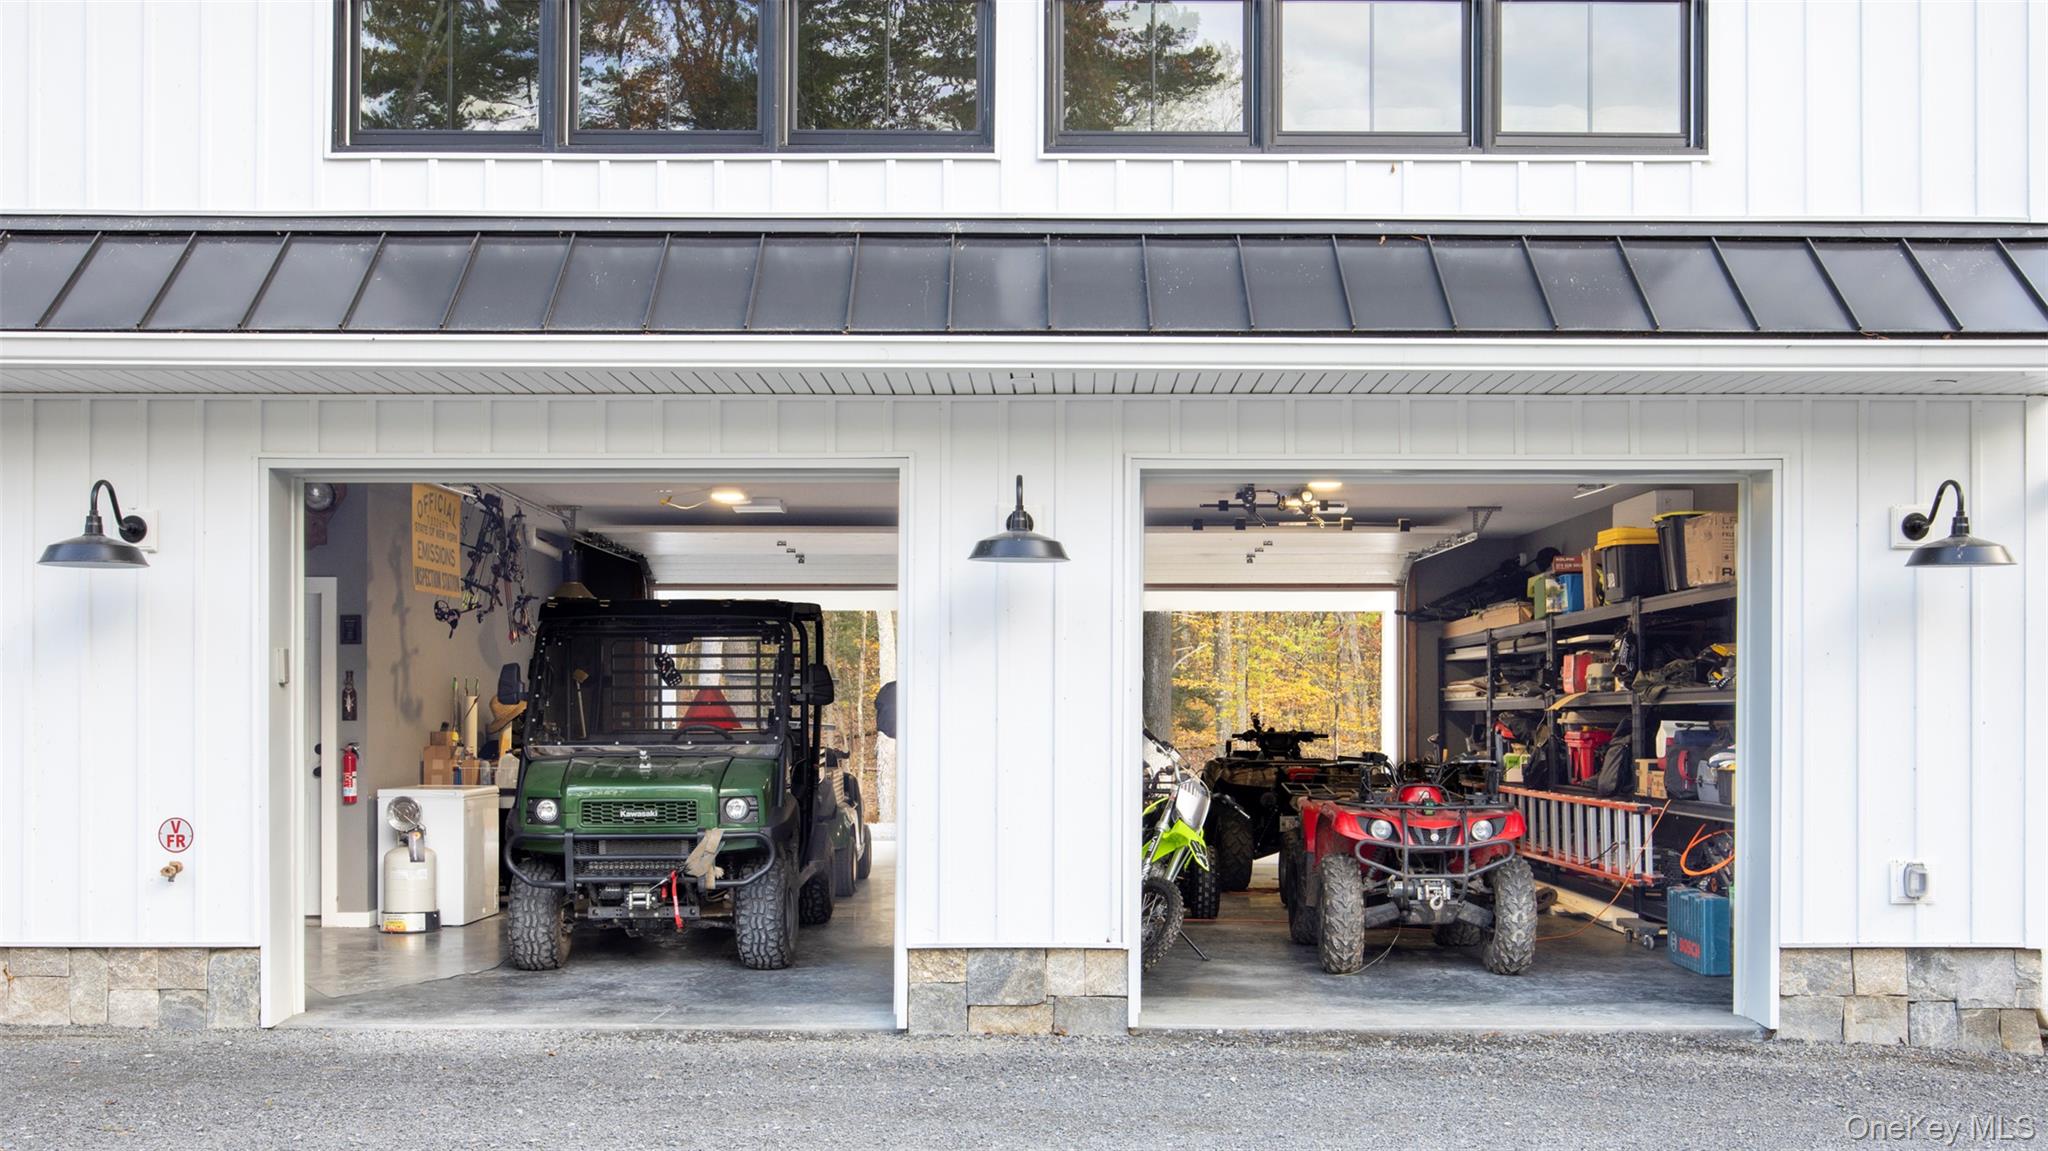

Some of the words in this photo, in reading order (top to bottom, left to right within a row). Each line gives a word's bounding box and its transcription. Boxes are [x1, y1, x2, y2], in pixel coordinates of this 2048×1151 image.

[416, 492, 456, 529] OFFICIAL
[436, 528, 445, 539] NEW
[417, 540, 456, 568] EMISSIONS
[415, 566, 441, 588] INSPECTION
[620, 809, 658, 818] Kawasaki
[171, 820, 181, 833] V
[167, 834, 185, 847] FR
